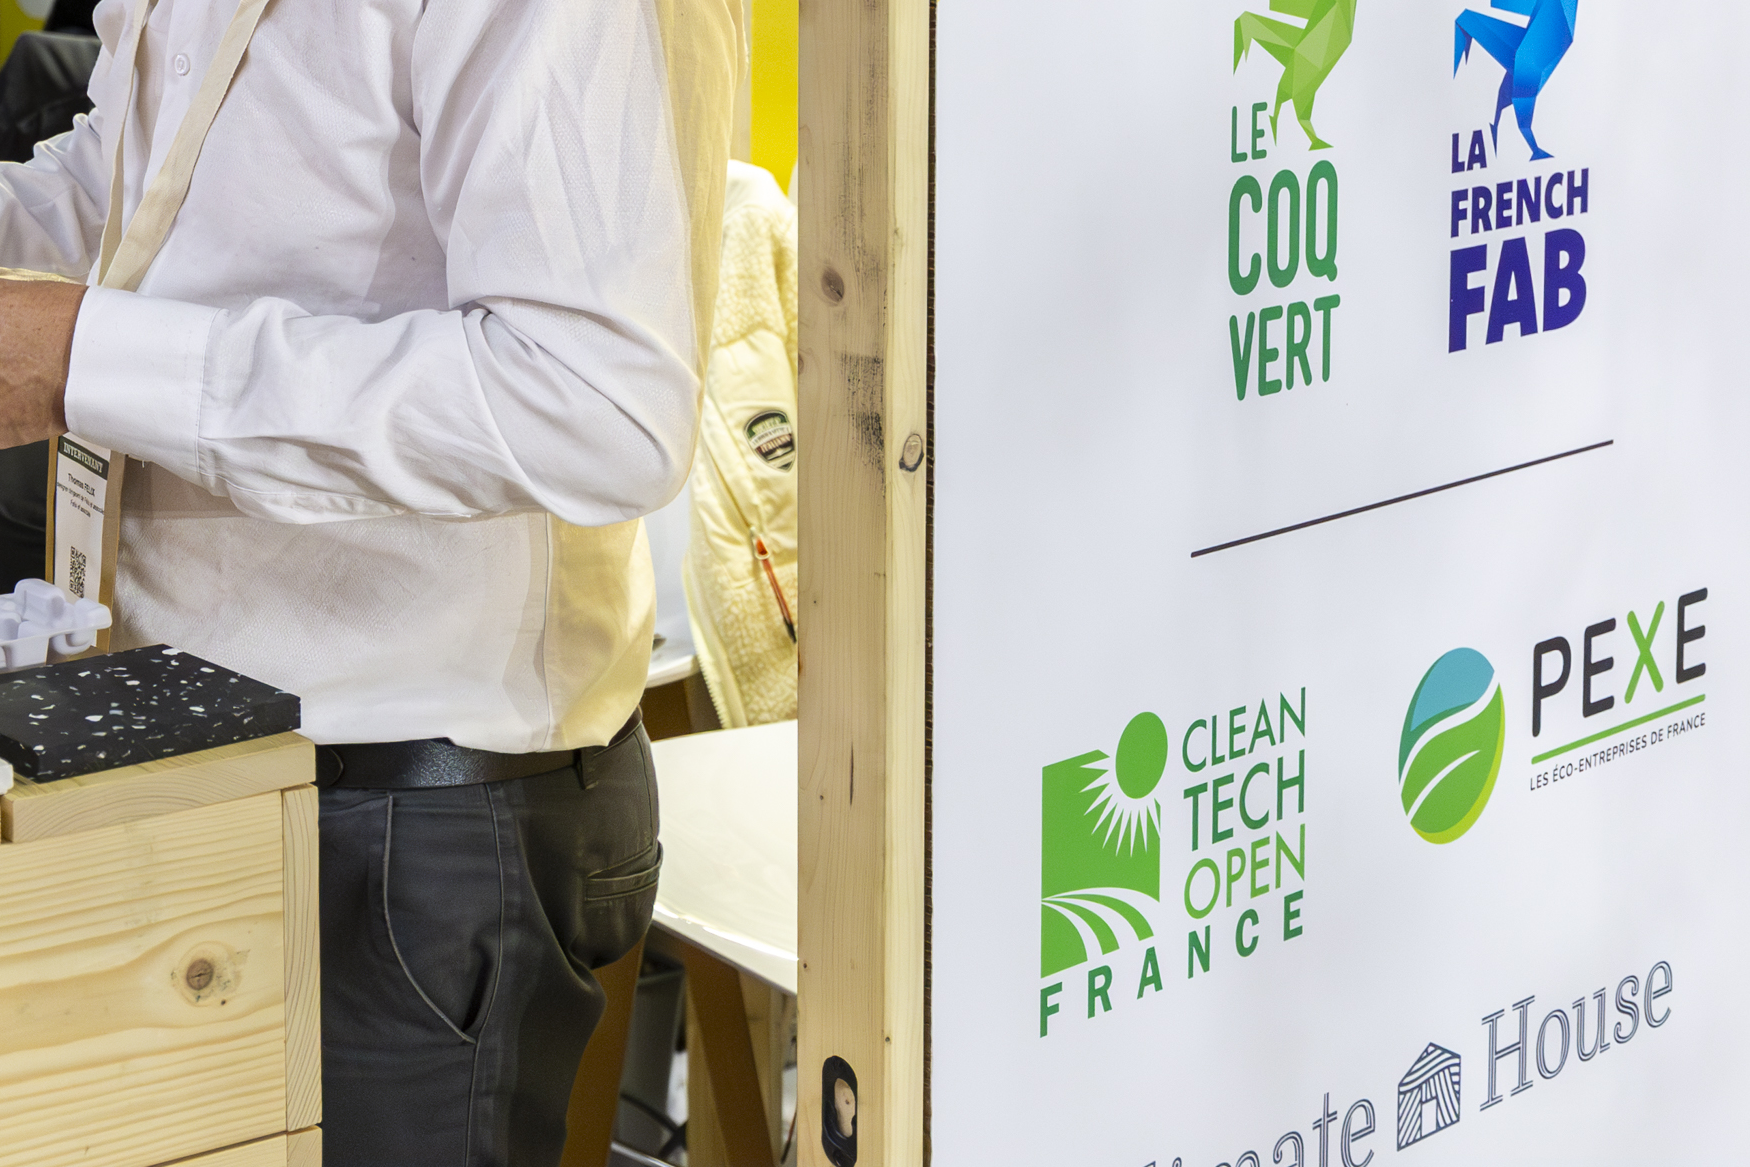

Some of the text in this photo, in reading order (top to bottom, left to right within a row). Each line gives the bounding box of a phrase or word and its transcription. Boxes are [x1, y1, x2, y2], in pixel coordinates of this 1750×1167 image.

[1231, 102, 1268, 163] LE
[1451, 129, 1487, 173] LA
[1228, 160, 1339, 296] COQ
[1451, 167, 1589, 238] FRENCH
[1448, 228, 1587, 354] FAB
[1228, 294, 1341, 401] VERT
[63, 441, 104, 473] INTERVENANT
[1531, 587, 1708, 738] PEXE
[1182, 686, 1306, 773] CLEAN
[1530, 712, 1706, 792] LES ÉCO-ENTREPRISES DE FRANCE
[1183, 749, 1305, 852] TECH
[1184, 824, 1306, 920] OPEN
[1040, 890, 1304, 1038] FRANCE
[1480, 960, 1674, 1112] House
